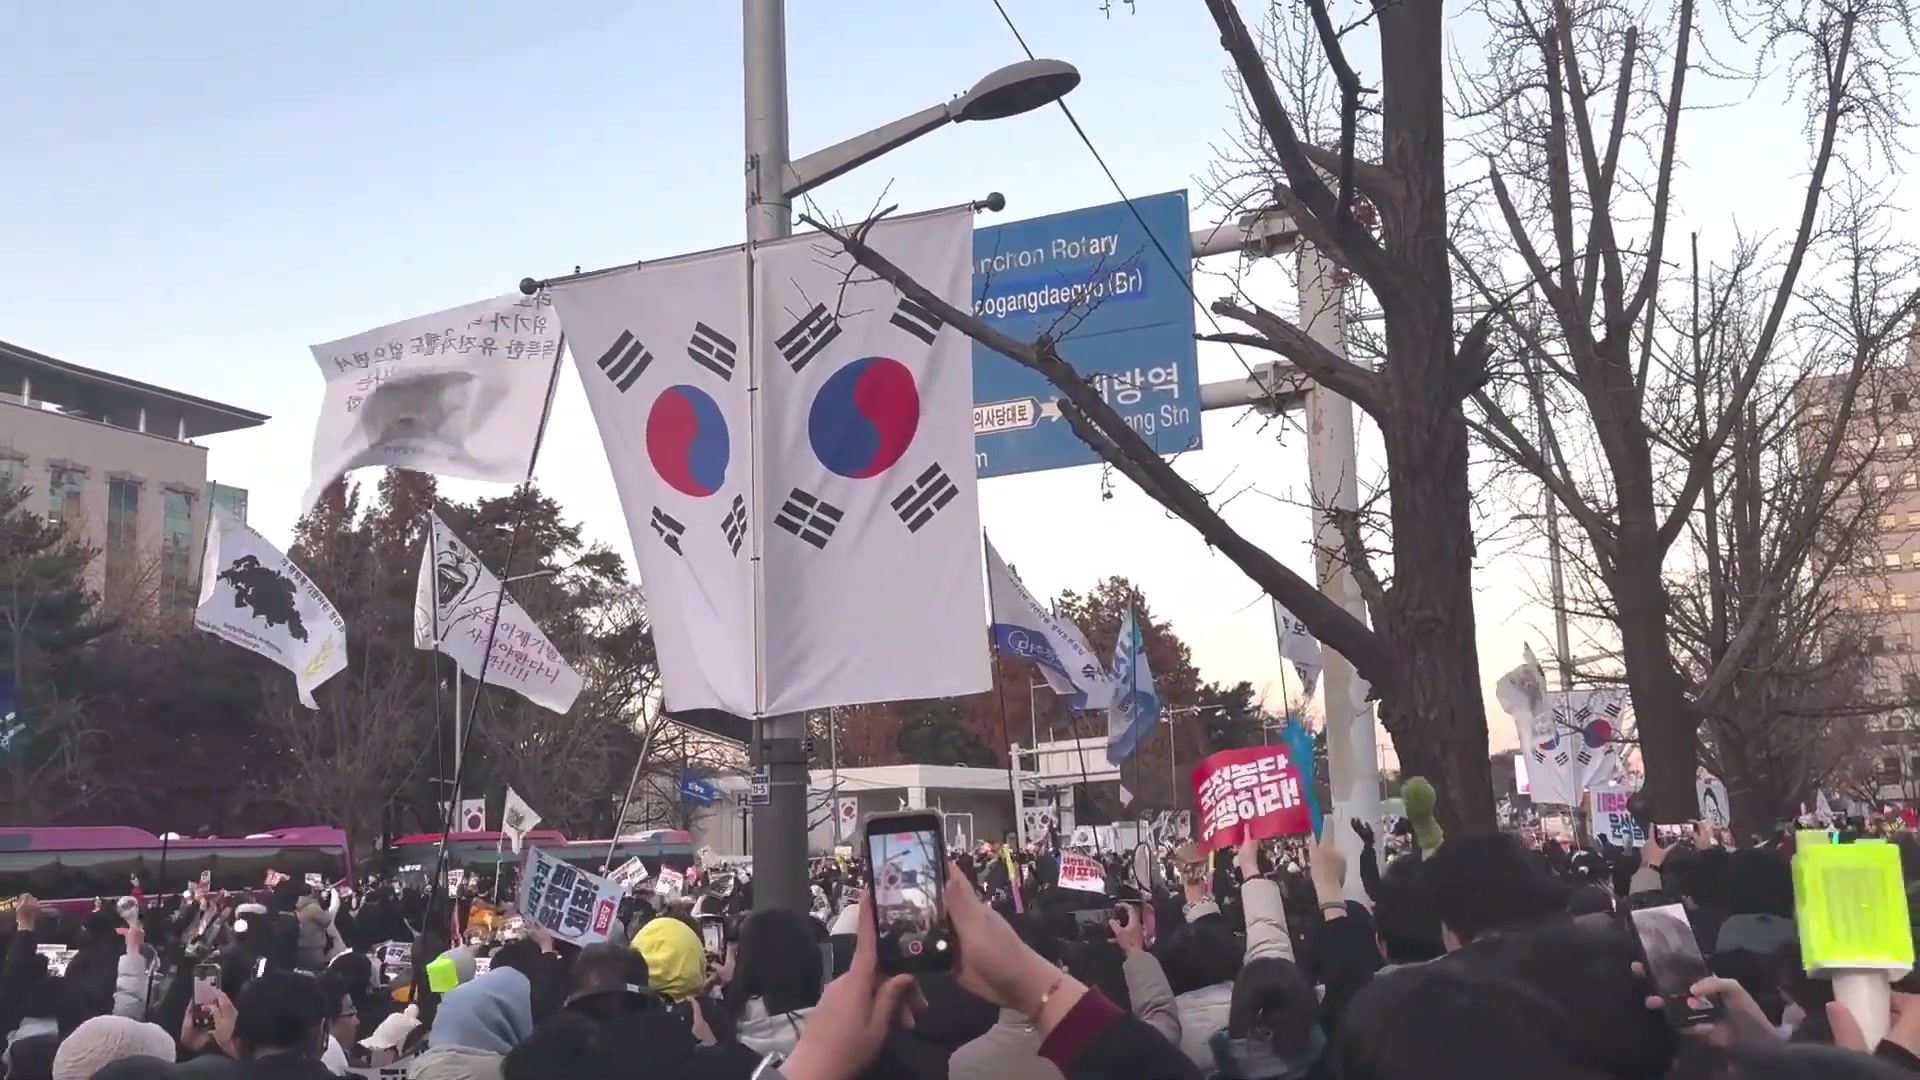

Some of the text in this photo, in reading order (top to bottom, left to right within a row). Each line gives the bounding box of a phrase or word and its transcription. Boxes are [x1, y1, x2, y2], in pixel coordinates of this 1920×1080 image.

[1052, 234, 1118, 260] Rotary
[1109, 268, 1143, 296] (Br)
[1161, 406, 1190, 427] Stn
